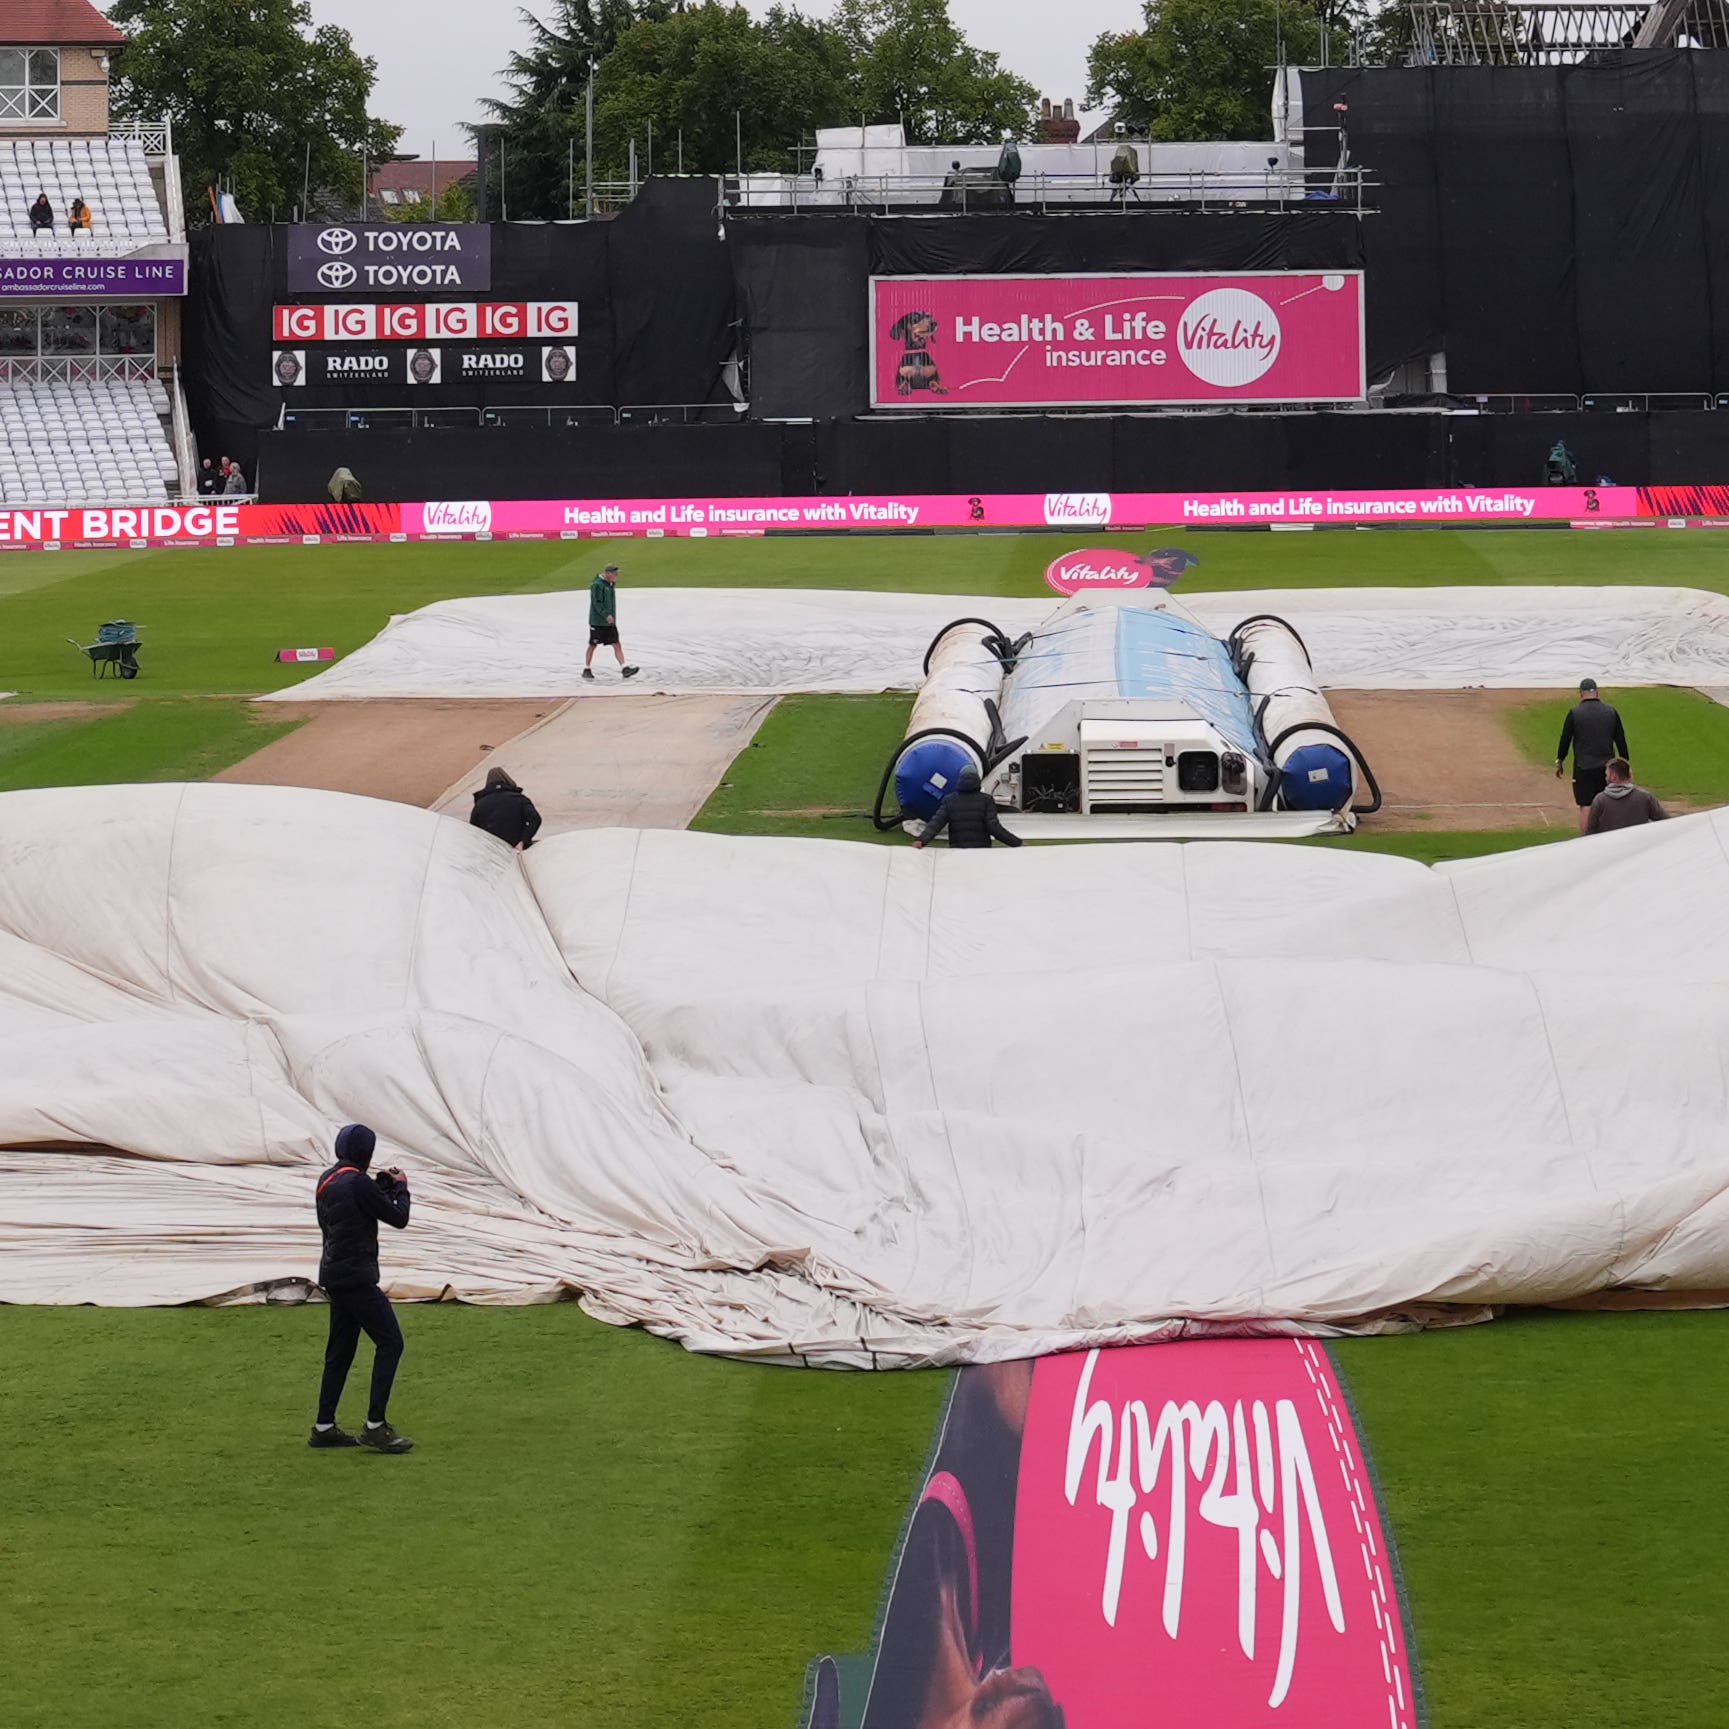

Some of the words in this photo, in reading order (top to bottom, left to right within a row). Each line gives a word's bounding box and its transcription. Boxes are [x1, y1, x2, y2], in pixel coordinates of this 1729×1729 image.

[364, 231, 461, 252] TOYOTA
[62, 266, 126, 279] CRUISE
[135, 266, 174, 279] LINE
[364, 265, 461, 285] TOYOTA
[1, 283, 105, 292] ambassadorcruiseline.com
[282, 308, 317, 337] IG
[334, 308, 366, 335] IG
[383, 307, 418, 336] IG
[435, 307, 468, 334] IG
[485, 305, 519, 334] IG
[537, 305, 569, 333] IG
[955, 314, 1065, 343] Health
[1073, 317, 1096, 341] &
[1104, 311, 1167, 341] Life
[1183, 313, 1276, 361] Vitality
[327, 355, 389, 371] RADO
[462, 353, 524, 369] RADO
[1045, 345, 1167, 367] insurance
[427, 502, 488, 532] Vitality
[564, 506, 624, 524] Health
[629, 506, 665, 522] and
[671, 505, 705, 522] Life
[709, 504, 800, 522] insurance
[804, 503, 846, 521] with
[849, 502, 919, 524] Vitality
[1048, 494, 1108, 524] Vitality
[1183, 500, 1244, 517] Health
[1249, 499, 1285, 516] and
[1289, 498, 1322, 515] Life
[1327, 497, 1416, 514] insurance
[1420, 496, 1462, 513] with
[1466, 495, 1535, 516] Vitality
[82, 507, 239, 538] BRIDGE
[1060, 563, 1139, 584] Vitality
[1065, 1347, 1345, 1709] Vitality
